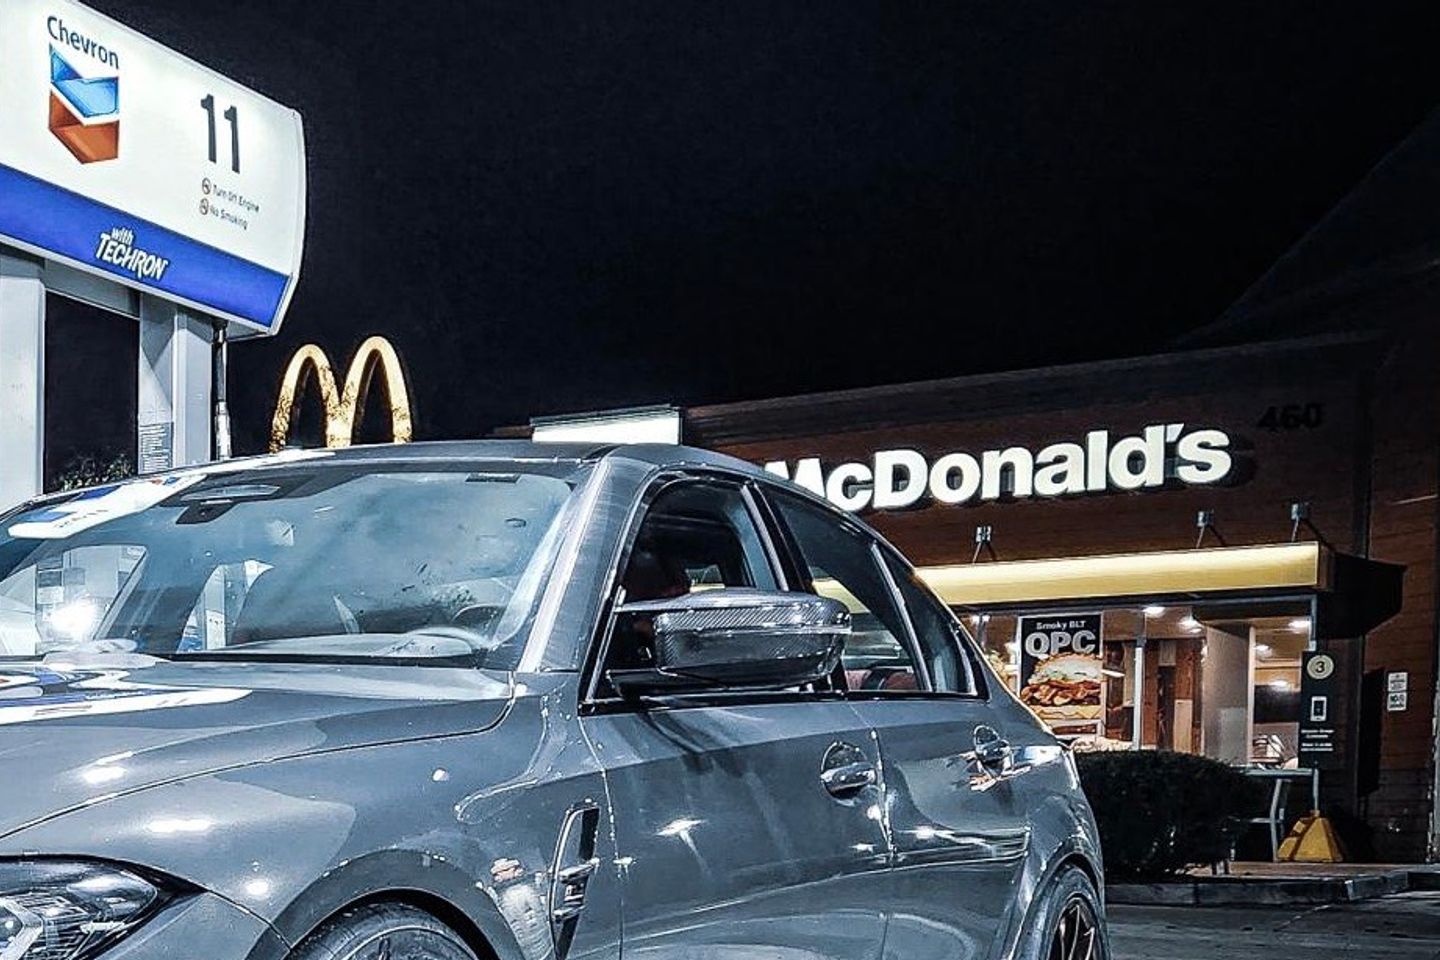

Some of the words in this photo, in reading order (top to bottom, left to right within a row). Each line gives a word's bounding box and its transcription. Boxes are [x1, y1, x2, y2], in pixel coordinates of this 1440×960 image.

[47, 15, 120, 70] Chevron
[200, 94, 241, 174] 11
[111, 227, 135, 246] with
[95, 232, 169, 281] TECHRON
[1256, 402, 1326, 433] 460
[1036, 621, 1067, 631] Smoky
[1069, 620, 1086, 629] BLT
[1024, 629, 1096, 661] QPC
[1315, 660, 1325, 674] 3
